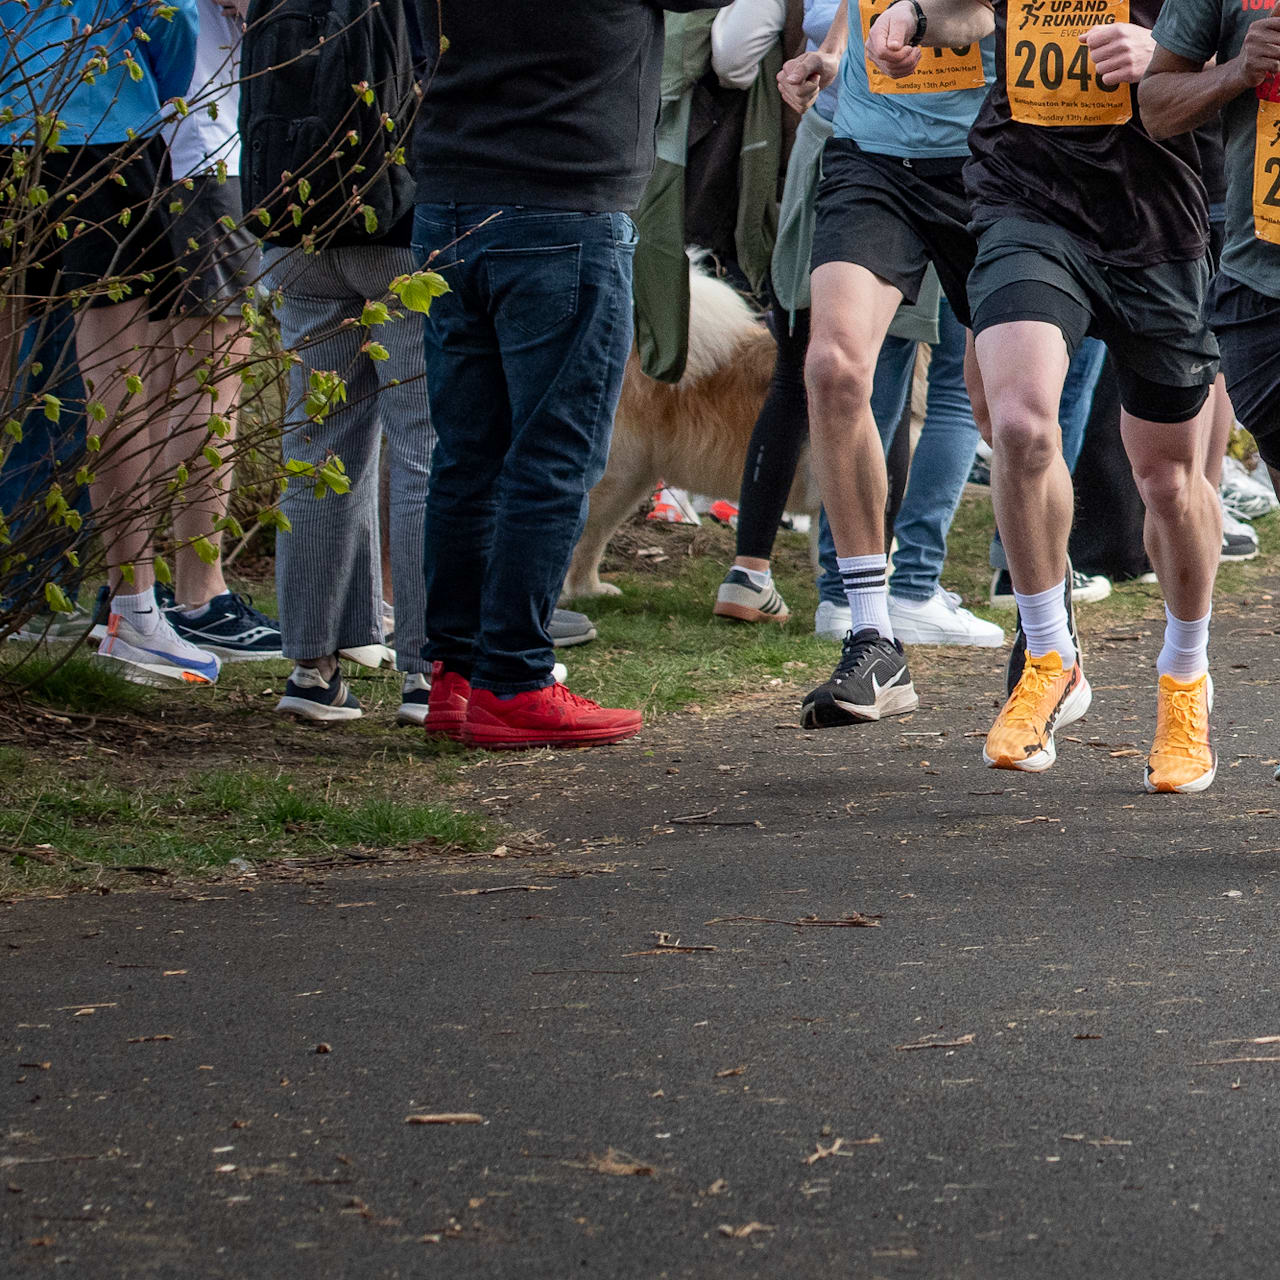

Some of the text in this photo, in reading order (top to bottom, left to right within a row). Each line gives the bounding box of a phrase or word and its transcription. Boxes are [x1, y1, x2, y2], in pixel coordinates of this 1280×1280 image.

[1050, 0, 1108, 13] UP AND
[1042, 13, 1116, 27] RUNNING
[895, 80, 957, 90] Sunday 13th April
